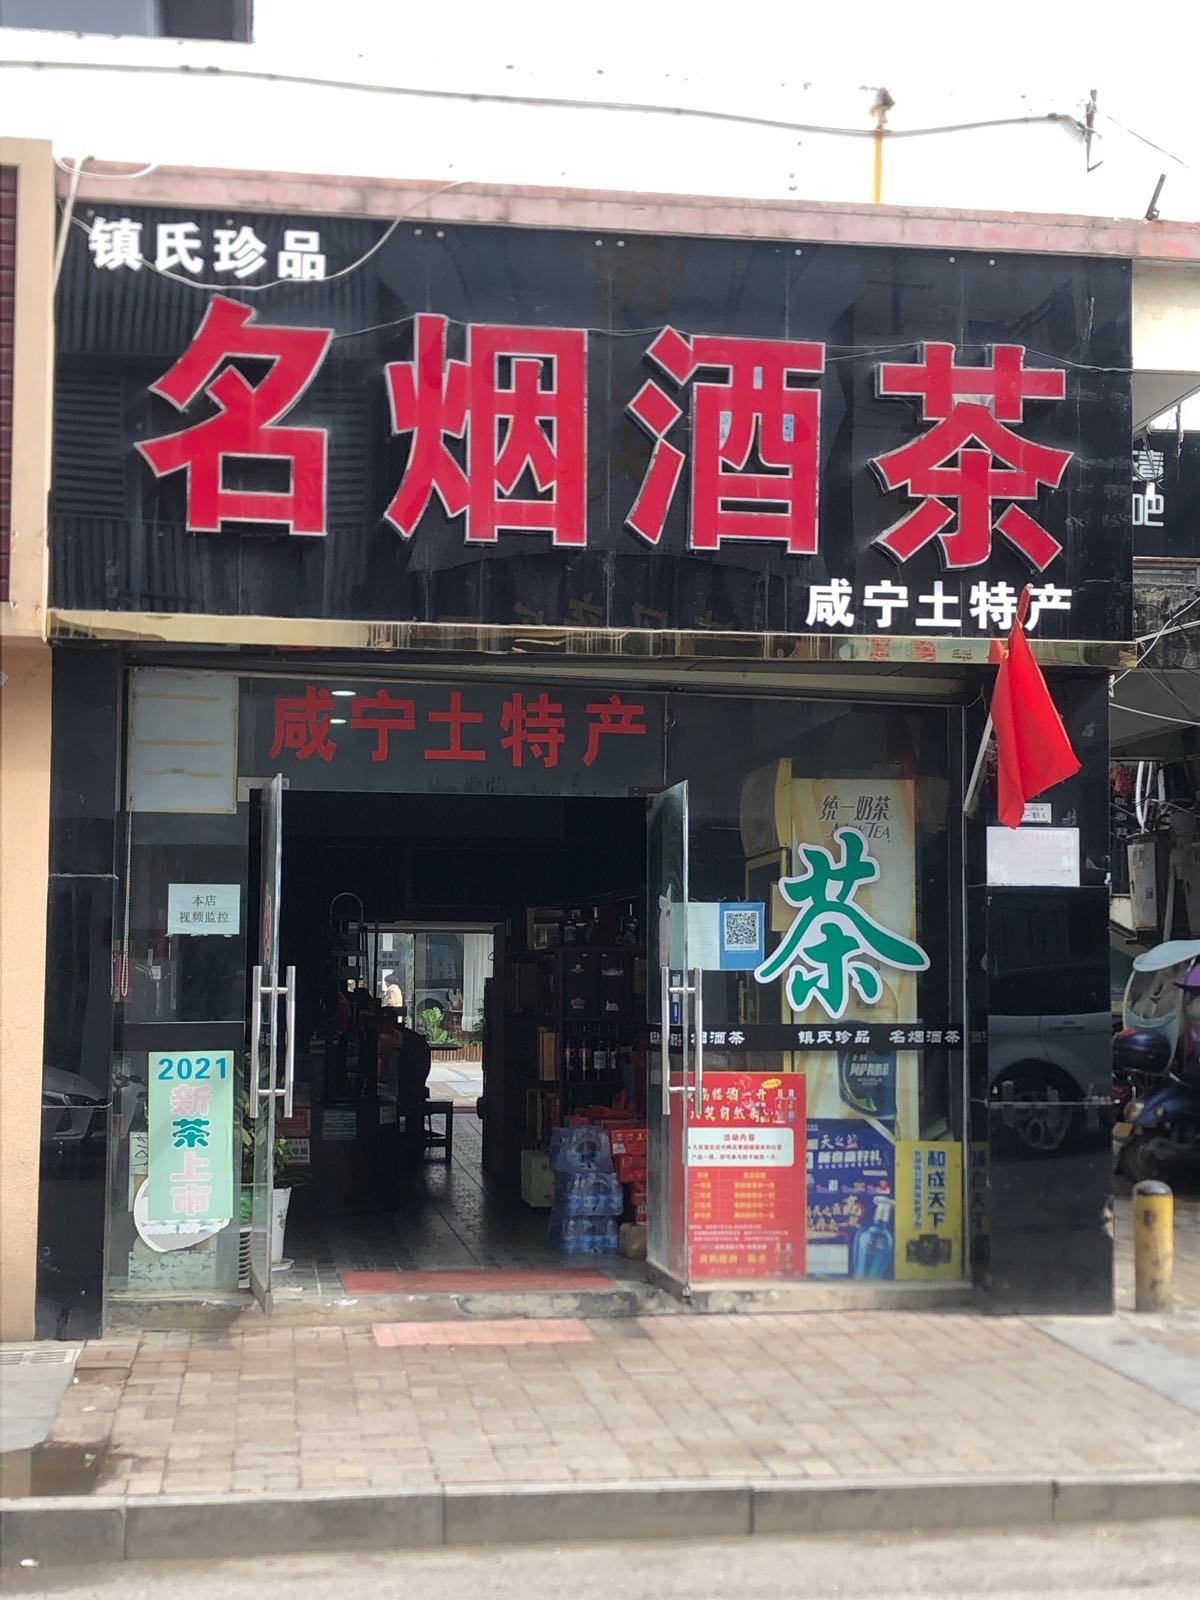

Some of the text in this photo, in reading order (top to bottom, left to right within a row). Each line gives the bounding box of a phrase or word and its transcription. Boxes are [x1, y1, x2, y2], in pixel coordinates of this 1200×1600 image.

[88, 217, 327, 281] 镇氏珍品
[134, 293, 1074, 574] 名烟酒茶
[805, 577, 1073, 632] 咸宁土特产
[268, 685, 648, 768] 咸宁土特产
[819, 794, 892, 821] 统一奶茶
[178, 911, 230, 925] 视频监控
[191, 893, 218, 908] 本店
[756, 827, 931, 1019] 茶
[798, 1030, 871, 1045] 镇氏珍品
[889, 1030, 962, 1045] 名烟酒茶
[157, 1057, 227, 1080] 2021
[169, 1083, 212, 1216] 新茶上市
